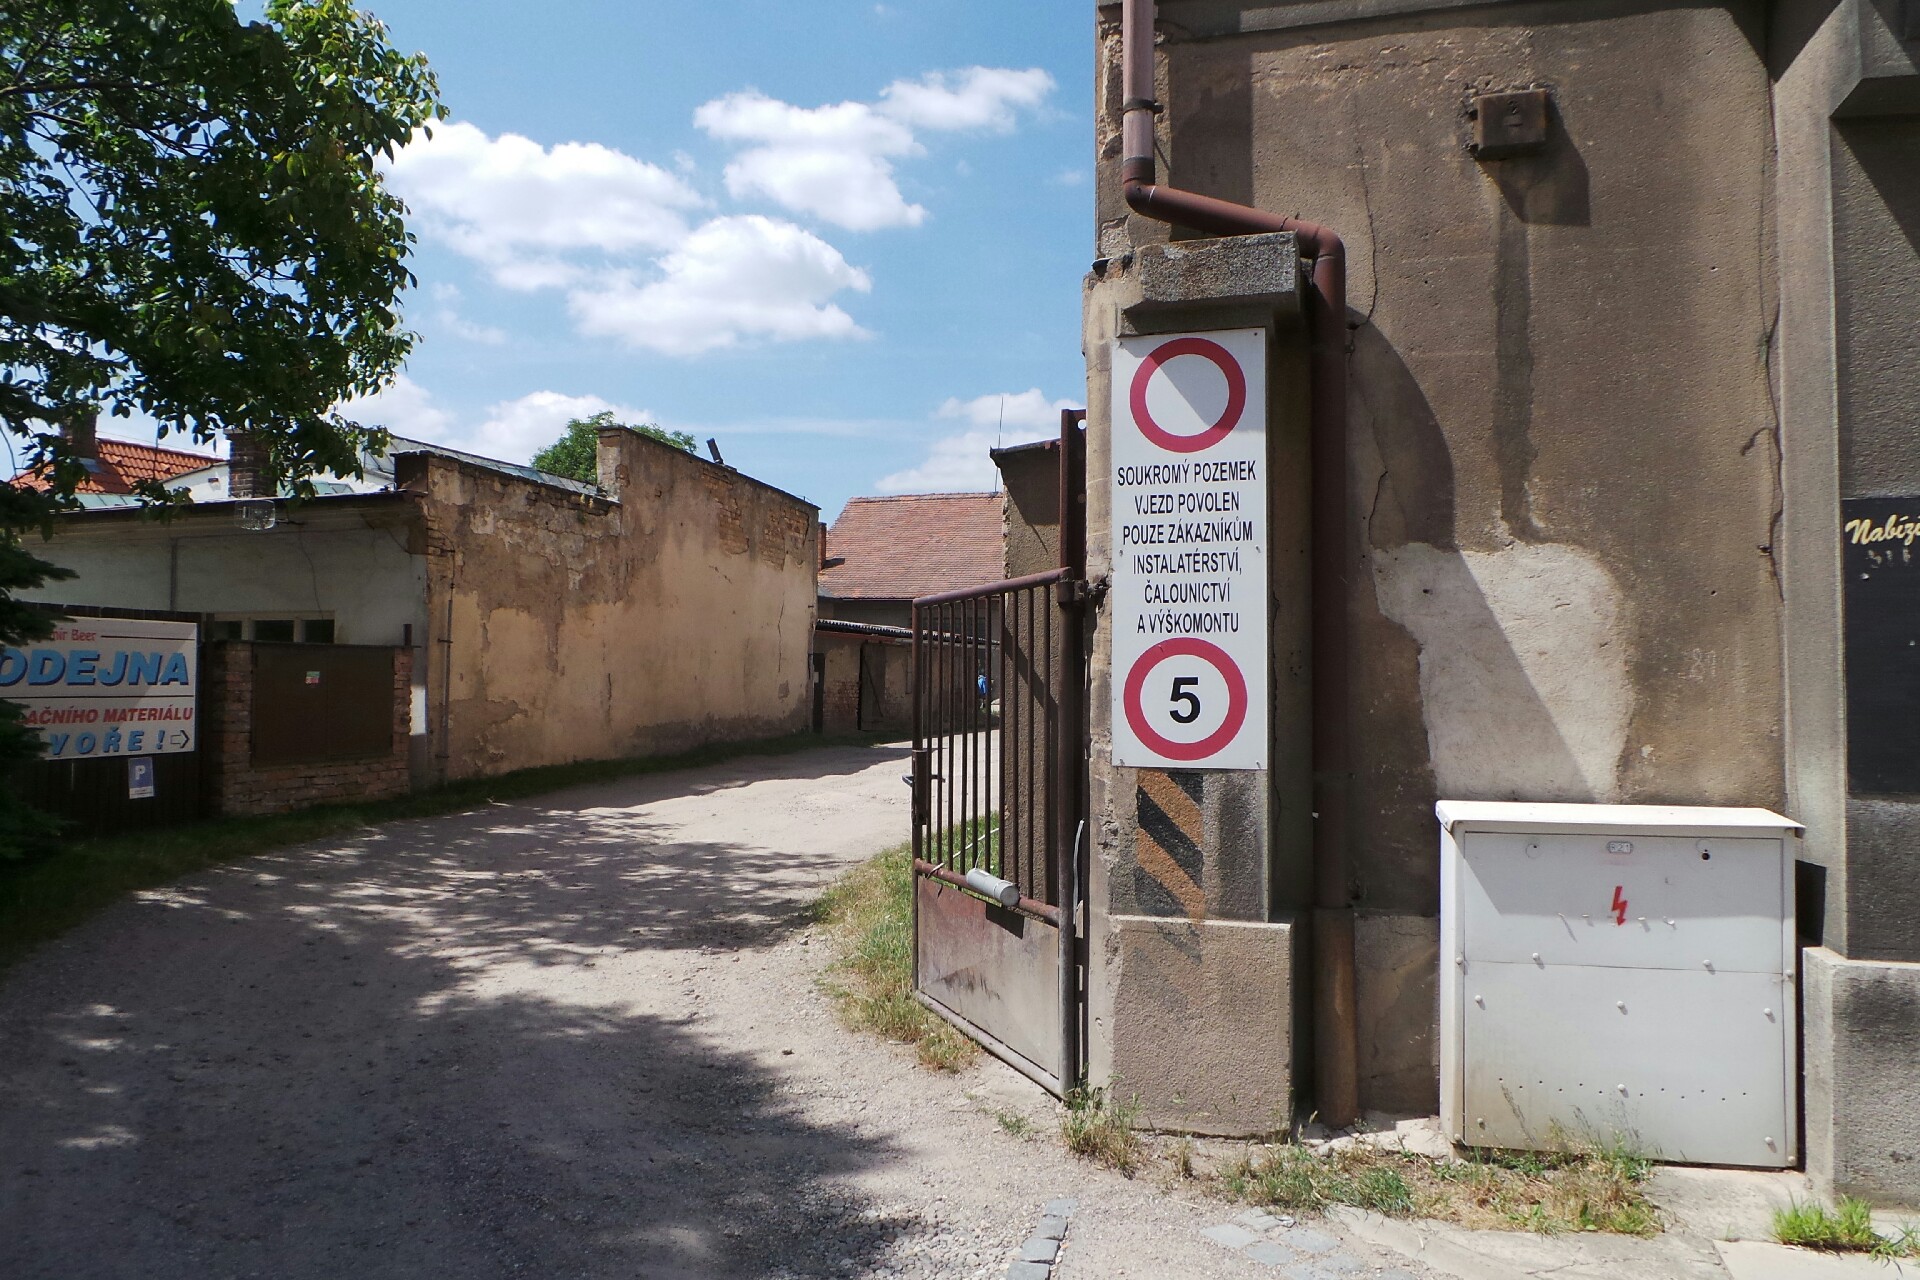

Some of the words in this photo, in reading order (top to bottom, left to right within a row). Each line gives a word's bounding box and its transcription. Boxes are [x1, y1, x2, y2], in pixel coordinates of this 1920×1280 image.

[1117, 459, 1190, 486] SOUKROMÝ
[1194, 460, 1257, 482] POZEMEK
[1134, 494, 1174, 515] VJEZD
[1178, 491, 1240, 513] POVOLEN
[1123, 524, 1165, 545] POUZE
[1168, 516, 1253, 544] ZÁKAZNÍKŮM
[1133, 547, 1242, 575] INSTALATÉRSTVÍ,
[1144, 577, 1231, 604] ČALOUNICTVÍ
[1137, 614, 1146, 634] A
[1149, 608, 1239, 634] VÝŠKOMONTU
[72, 628, 97, 641] Beer
[1169, 676, 1201, 724] 5
[103, 704, 194, 723] MATERIÁLU
[135, 764, 146, 780] P
